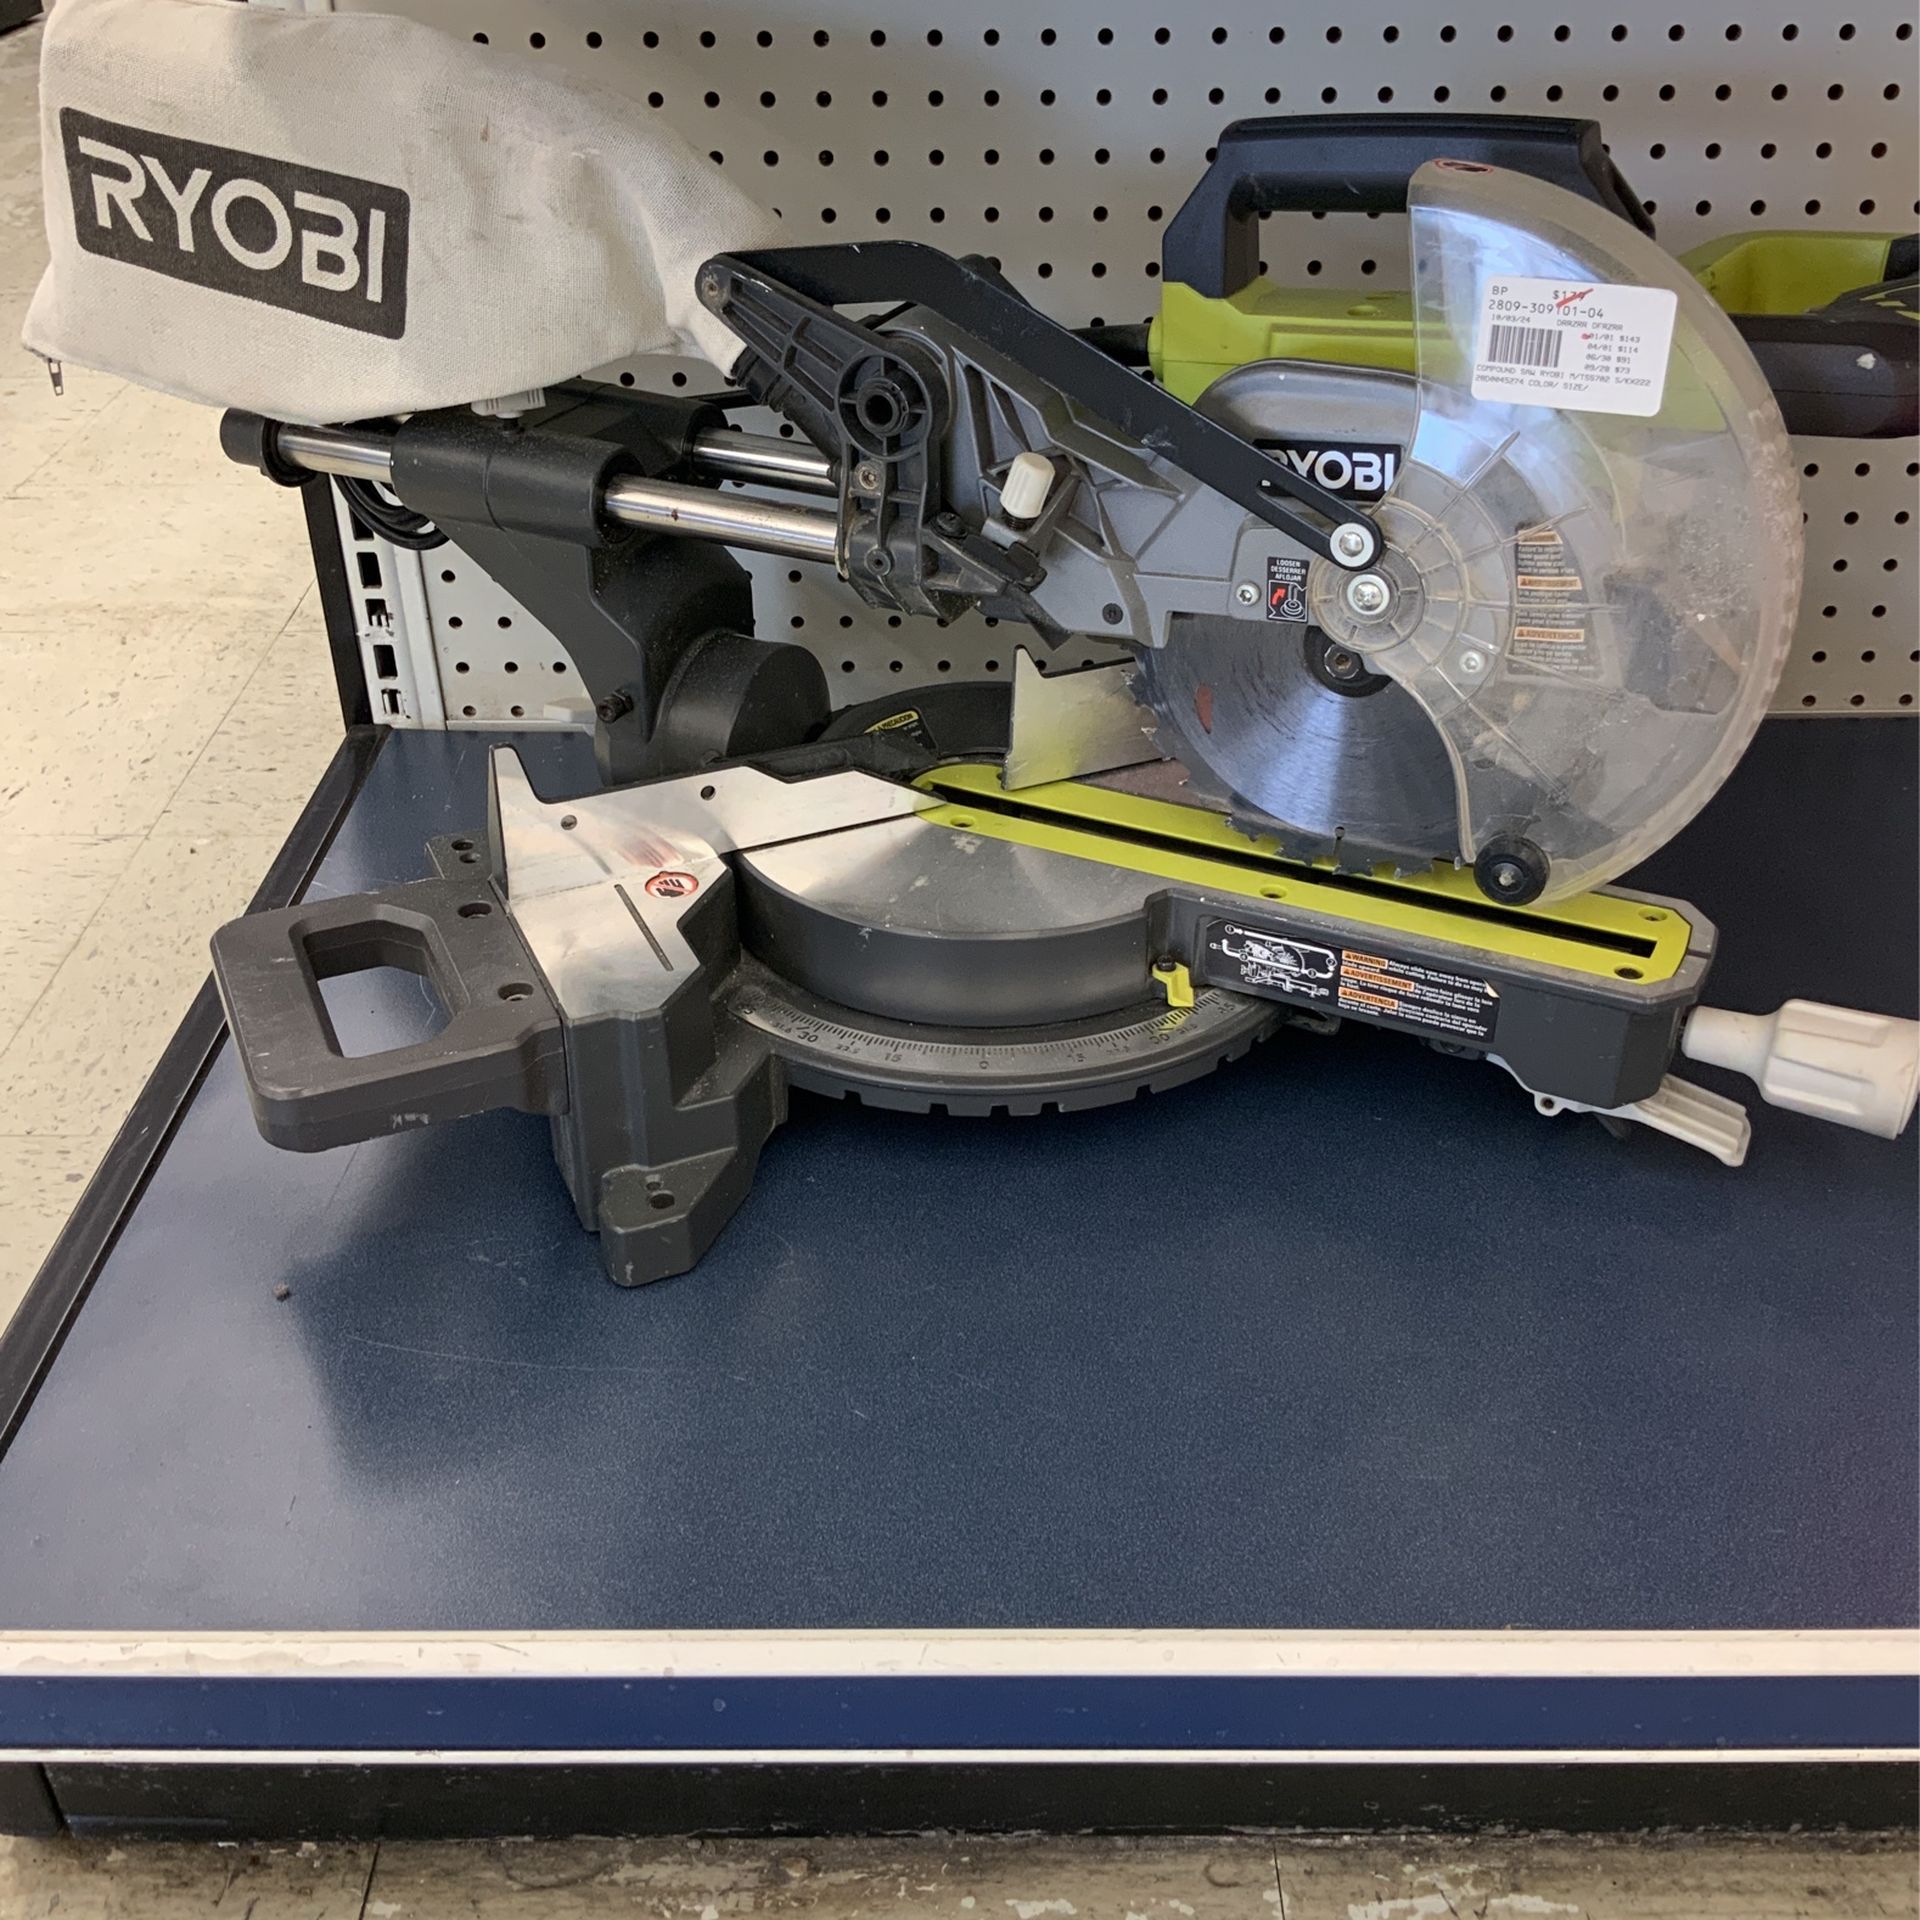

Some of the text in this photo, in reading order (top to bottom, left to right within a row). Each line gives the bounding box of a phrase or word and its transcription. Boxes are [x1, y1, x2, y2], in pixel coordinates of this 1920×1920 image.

[78, 136, 386, 303] RYOBI
[1492, 286, 1508, 296] BP
[1489, 300, 1604, 318] 2809-309101-04
[1492, 314, 1530, 323] 10/03/24
[1477, 364, 1516, 374] COMPOUND
[1521, 368, 1536, 377] SAW
[1540, 369, 1564, 379] RYOBI
[1615, 365, 1630, 374] $73
[1271, 566, 1306, 575] DESSERRER
[1275, 573, 1301, 581] AFLOJAR
[1351, 953, 1385, 966] WARNING
[1347, 990, 1394, 1007] ADVERTENCIA
[797, 1031, 819, 1042] 30
[884, 1053, 902, 1063] 15
